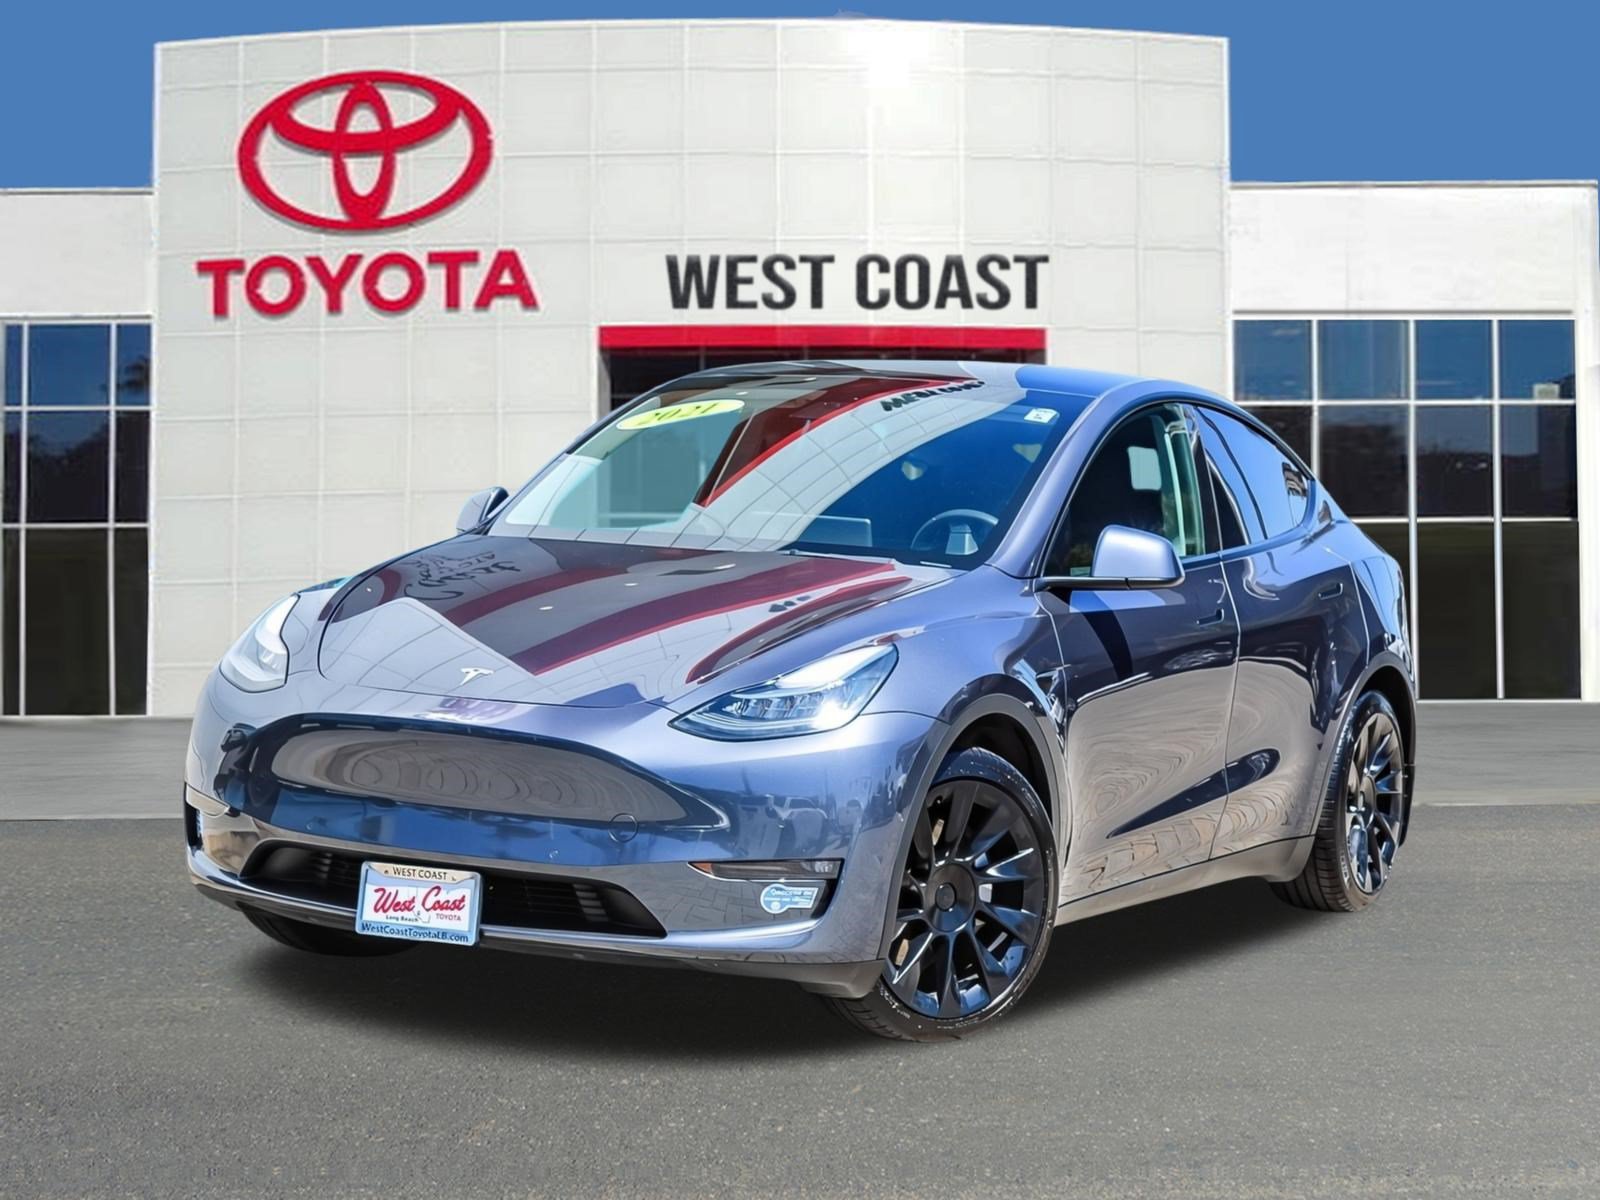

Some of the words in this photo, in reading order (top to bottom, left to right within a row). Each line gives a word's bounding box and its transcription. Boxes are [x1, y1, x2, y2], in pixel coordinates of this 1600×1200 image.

[196, 250, 539, 317] TOYOTA
[665, 253, 835, 310] WEST
[855, 253, 1050, 310] COAST
[393, 866, 416, 877] WEST
[418, 869, 448, 881] COAST
[374, 888, 416, 913] West
[421, 885, 466, 912] Coast
[401, 915, 419, 923] Beach
[435, 913, 462, 921] TOYOTA
[361, 923, 469, 942] WestCoastToyotaLB.com
